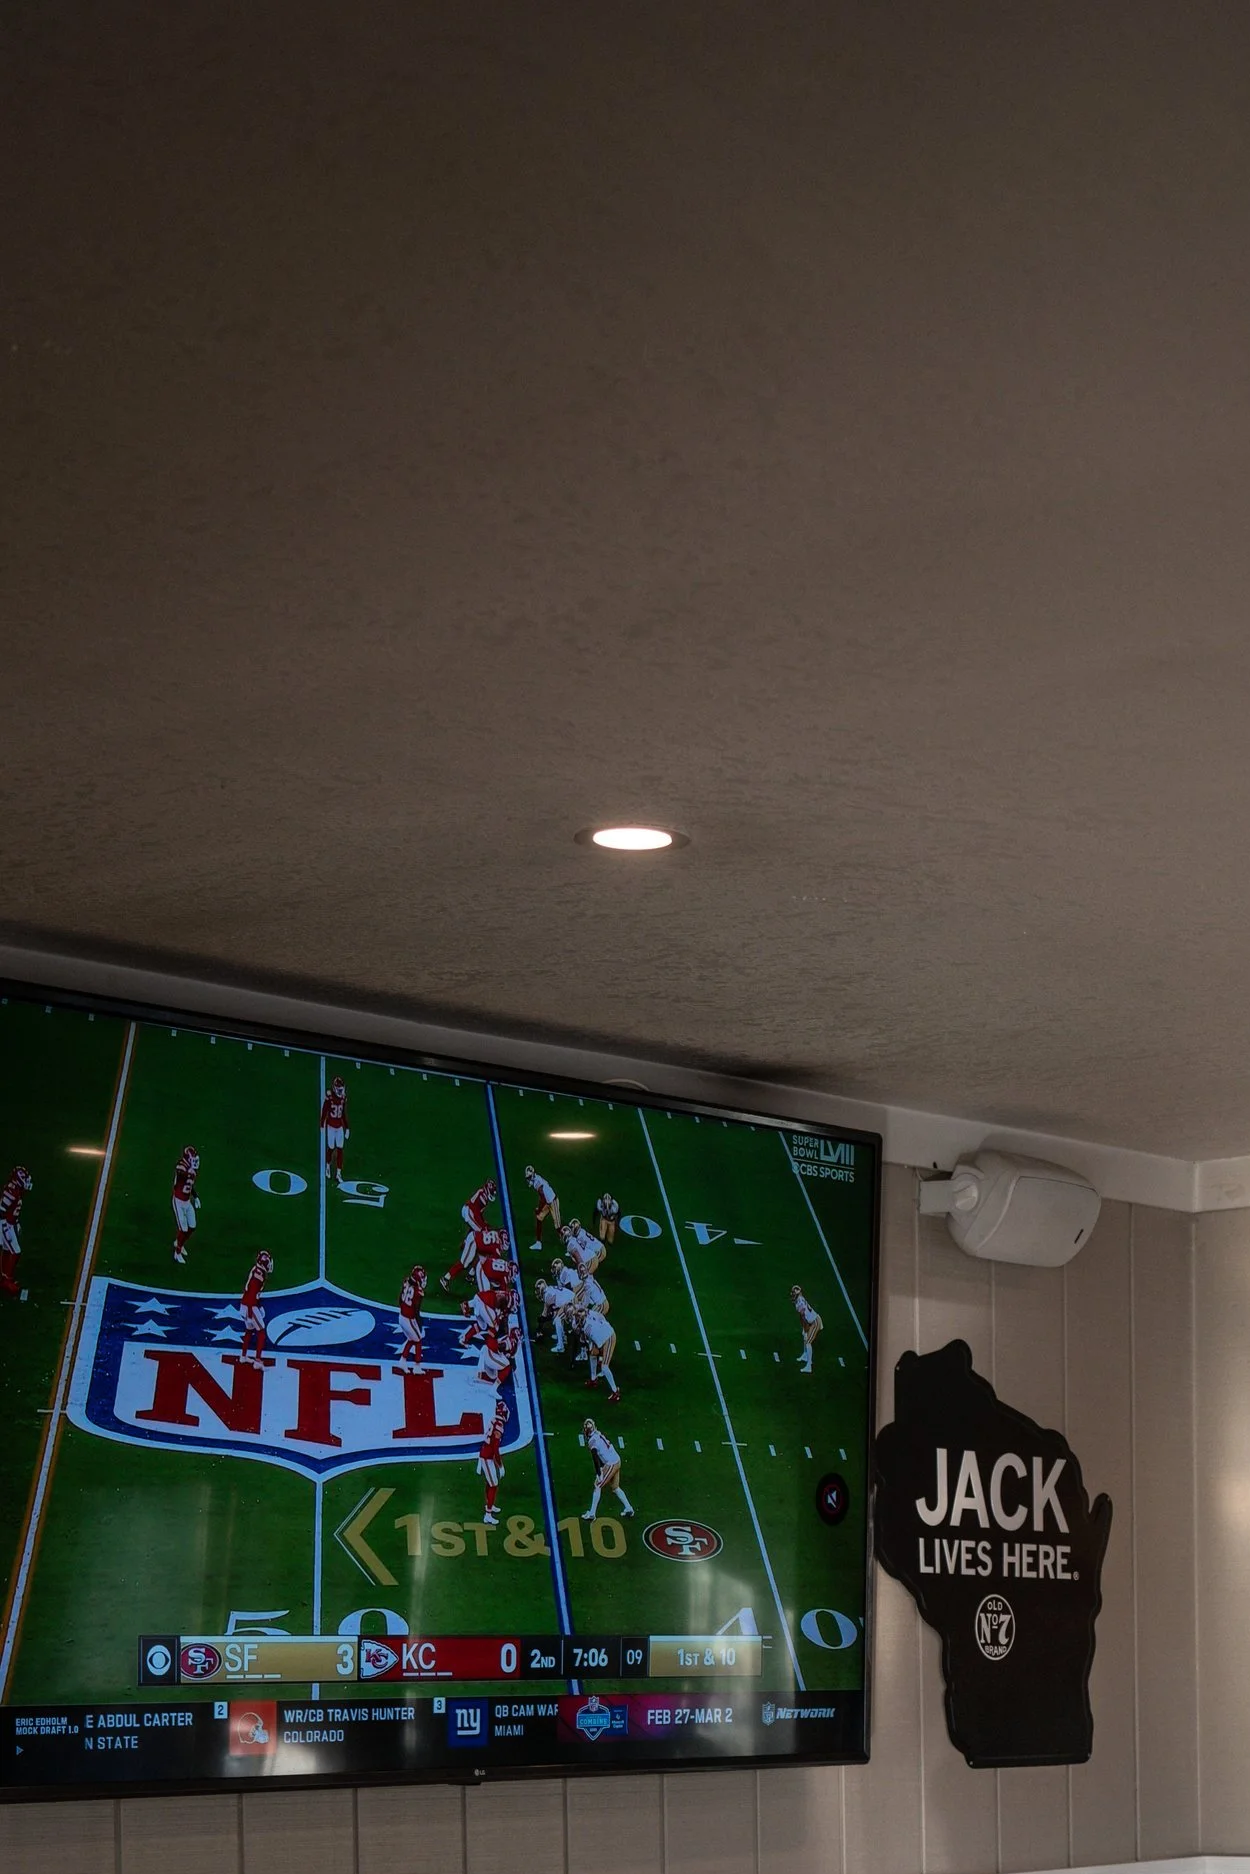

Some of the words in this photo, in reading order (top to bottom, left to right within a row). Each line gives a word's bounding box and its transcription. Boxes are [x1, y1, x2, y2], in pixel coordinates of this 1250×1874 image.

[792, 1134, 819, 1148] SUPER
[792, 1146, 819, 1160] BOWL
[820, 1139, 855, 1166] LVIII
[800, 1163, 818, 1177] CBS
[819, 1166, 855, 1183] SPORTS
[134, 1349, 485, 1448] NFL
[915, 1448, 1070, 1534] JACK
[918, 1537, 993, 1577] LIVES
[987, 1600, 1003, 1611] OLD
[402, 1642, 436, 1669] KC
[500, 1643, 517, 1674] 0
[530, 1649, 556, 1668] 2ND
[573, 1648, 609, 1667] 7:06
[626, 1649, 643, 1665] 09
[677, 1649, 700, 1666] 1ST
[703, 1648, 716, 1666] &
[720, 1648, 736, 1666] 10
[984, 1645, 1007, 1656] BRAND
[224, 1643, 258, 1672] SF
[336, 1643, 355, 1675] 3
[217, 1704, 224, 1716] 2
[436, 1700, 442, 1711] 3
[494, 1704, 509, 1718] QB
[512, 1704, 534, 1717] CAM
[97, 1713, 140, 1728] ABDUL
[143, 1712, 193, 1727] CARTER
[284, 1708, 324, 1723] WR/CB
[328, 1708, 369, 1722] TRAVIS
[372, 1707, 415, 1721] HUNTER
[647, 1709, 671, 1725] FEB
[725, 1707, 733, 1723] 2
[776, 1707, 836, 1720] NETWORK
[15, 1717, 34, 1727] ERIC
[35, 1716, 68, 1726] EDHOLM
[15, 1726, 39, 1736] MOCK
[40, 1725, 66, 1735] DRAFT
[283, 1729, 345, 1744] COLORADO
[494, 1724, 524, 1737] MIAMI
[97, 1735, 139, 1750] STATE
